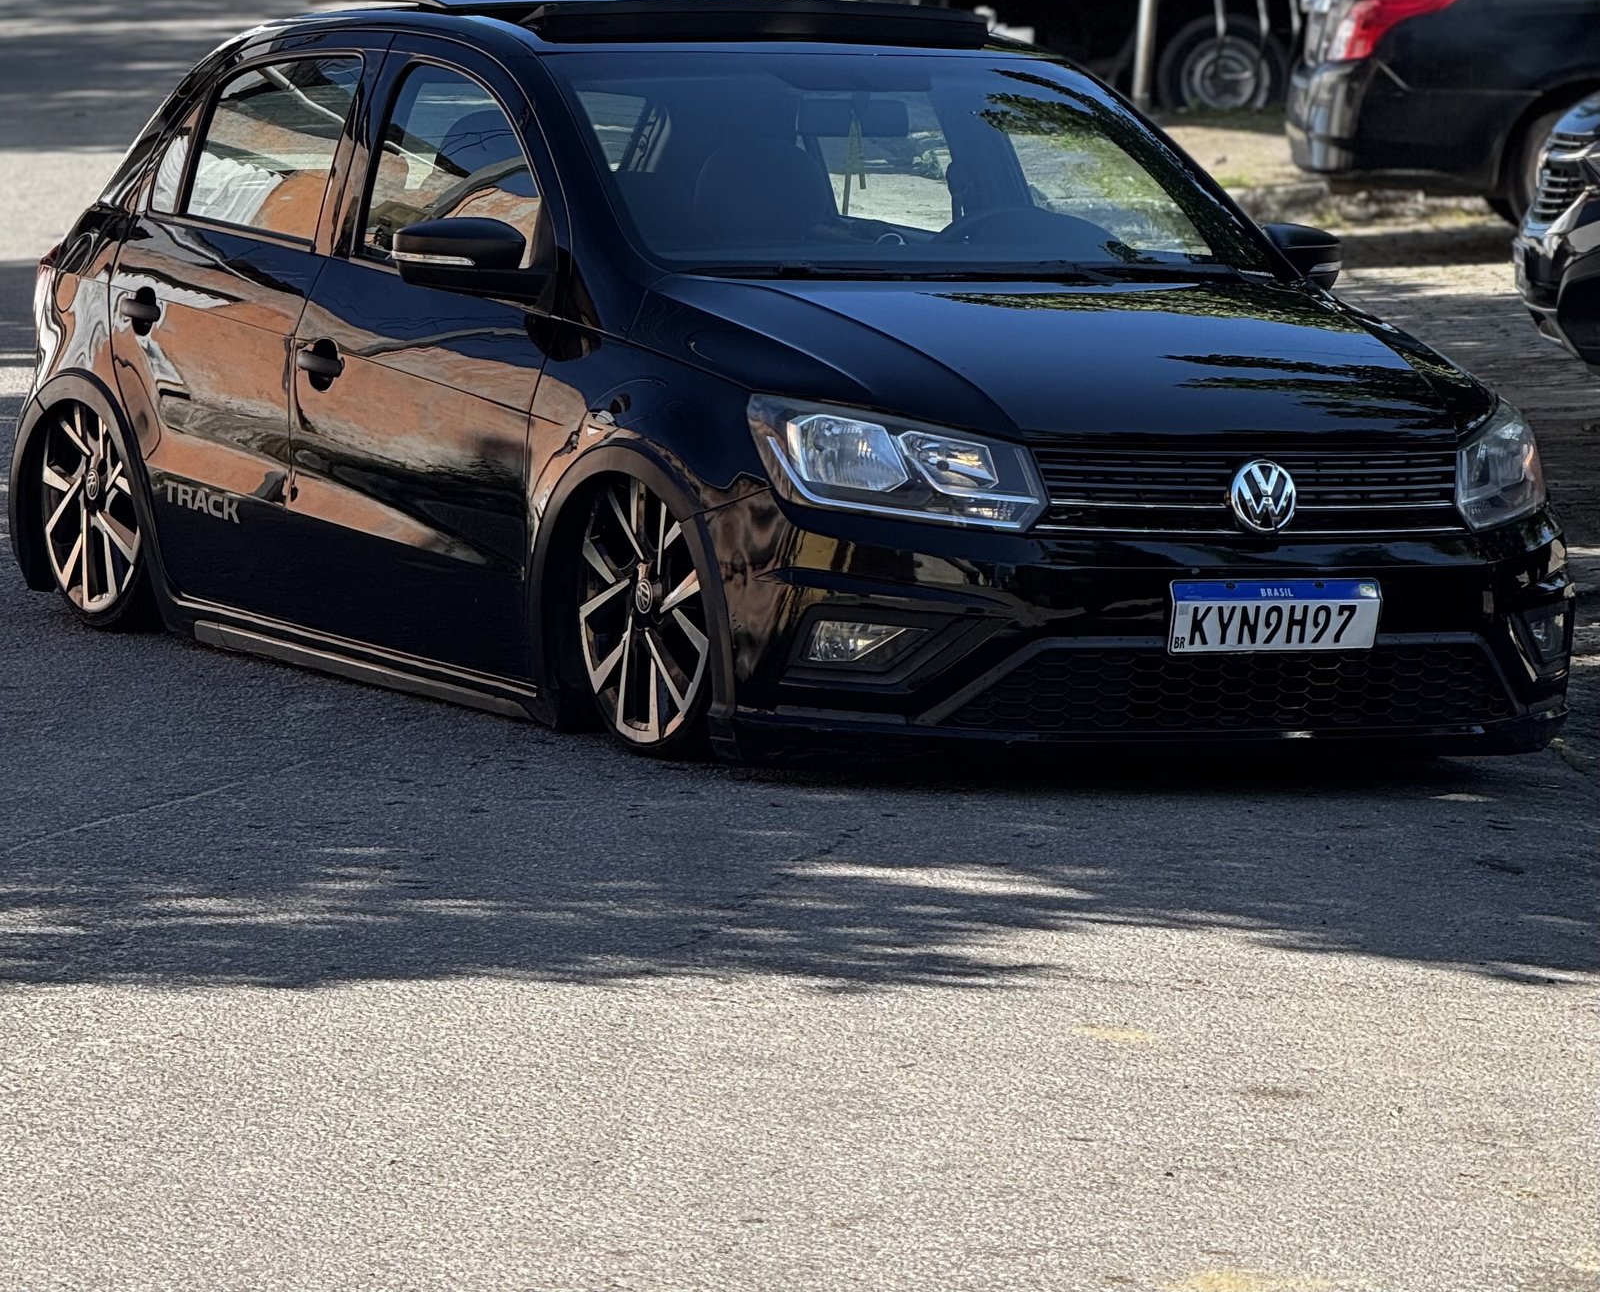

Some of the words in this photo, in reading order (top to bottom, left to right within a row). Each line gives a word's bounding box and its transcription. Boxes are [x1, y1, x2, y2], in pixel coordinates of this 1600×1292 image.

[163, 479, 241, 524] TRACK
[1235, 462, 1295, 529] VW
[1260, 587, 1294, 597] BRASIL
[1173, 636, 1186, 649] BR
[1188, 604, 1358, 646] KYN9H97
